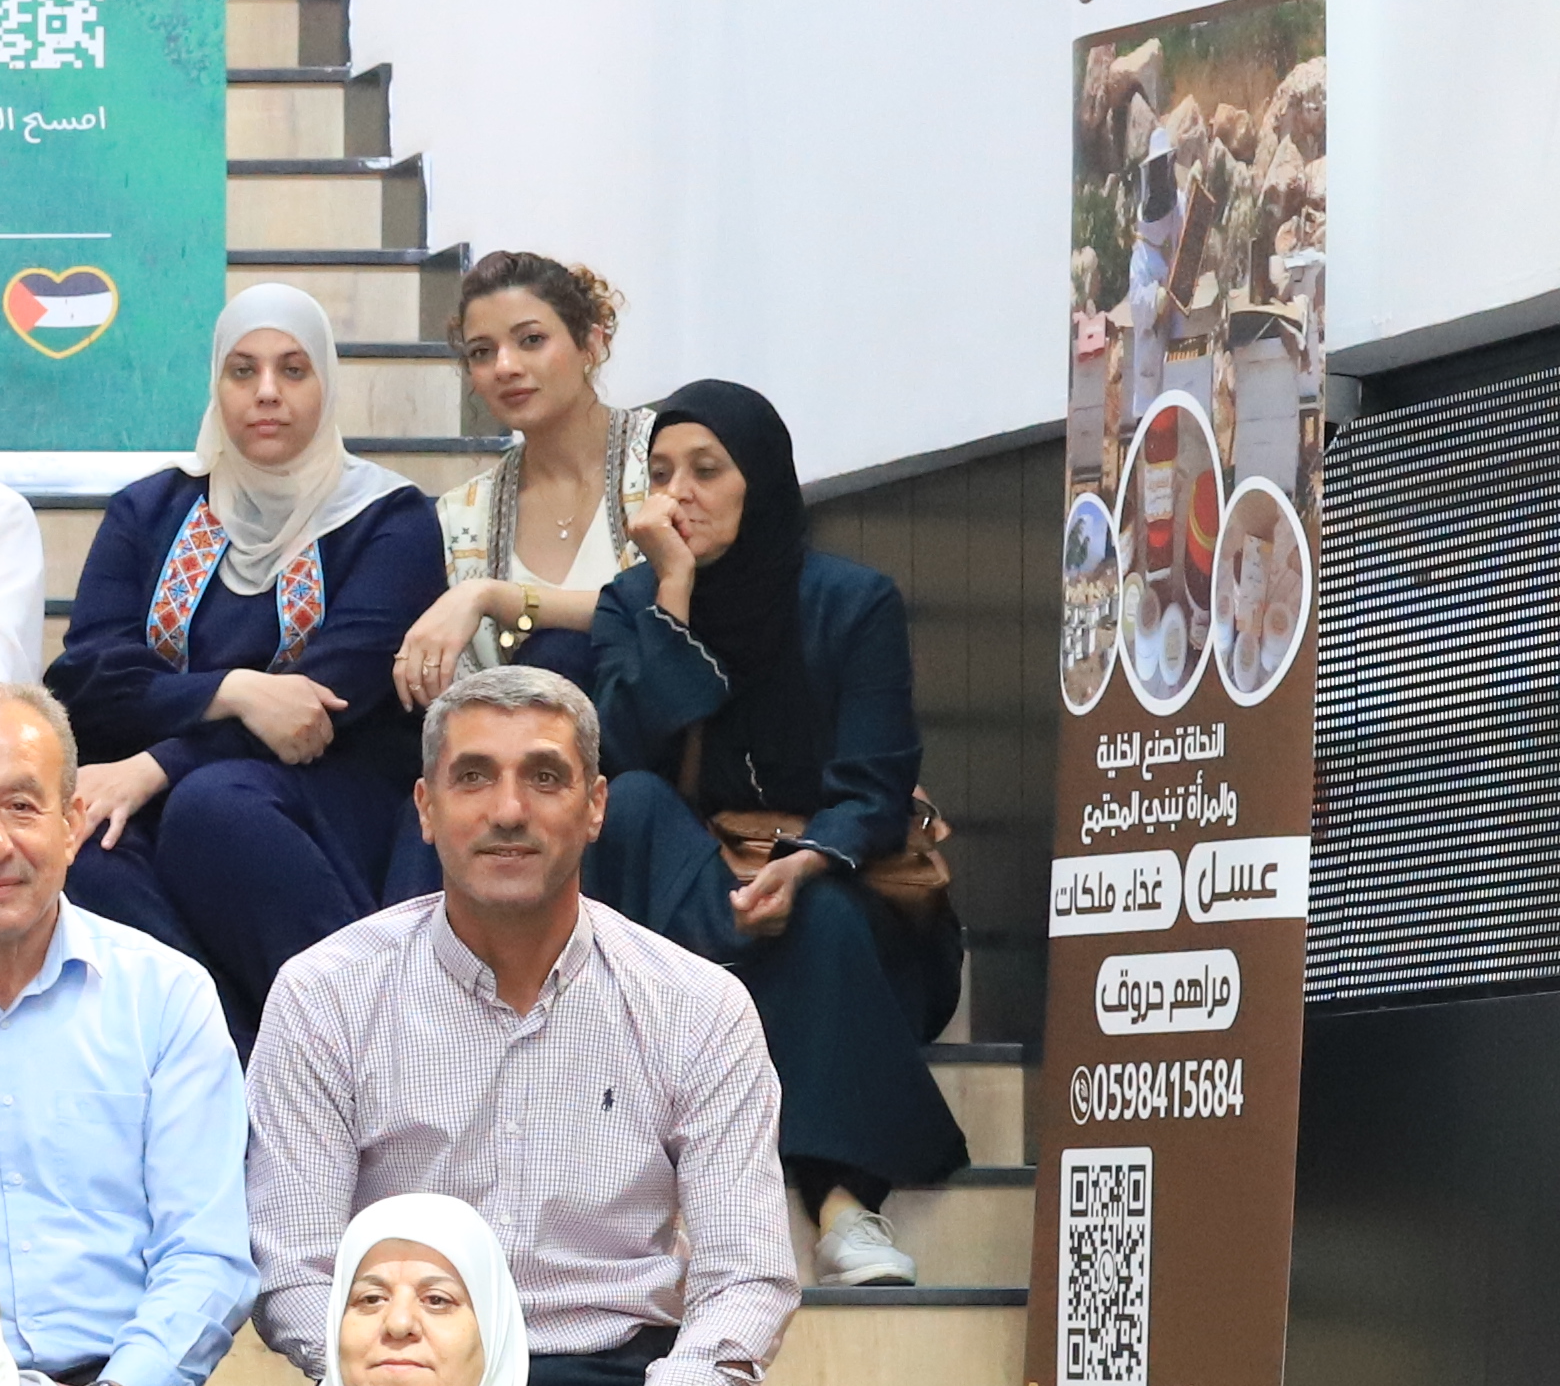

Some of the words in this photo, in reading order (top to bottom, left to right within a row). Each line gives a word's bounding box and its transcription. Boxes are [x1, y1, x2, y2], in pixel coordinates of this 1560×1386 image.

[21, 105, 107, 143] امسح
[1096, 731, 1140, 779] الخلية
[1142, 728, 1183, 780] تصنع
[1185, 722, 1225, 762] النحلة
[1081, 789, 1140, 845] المجتمع
[1142, 787, 1184, 835] تبني
[1186, 770, 1237, 828] والمرأة
[1055, 870, 1116, 919] ملكات
[1122, 866, 1163, 913] غذاء
[1199, 851, 1279, 914] عسل
[1101, 969, 1165, 1024] حروق
[1169, 965, 1232, 1024] مراهم
[1092, 1059, 1244, 1121] 0598415684
